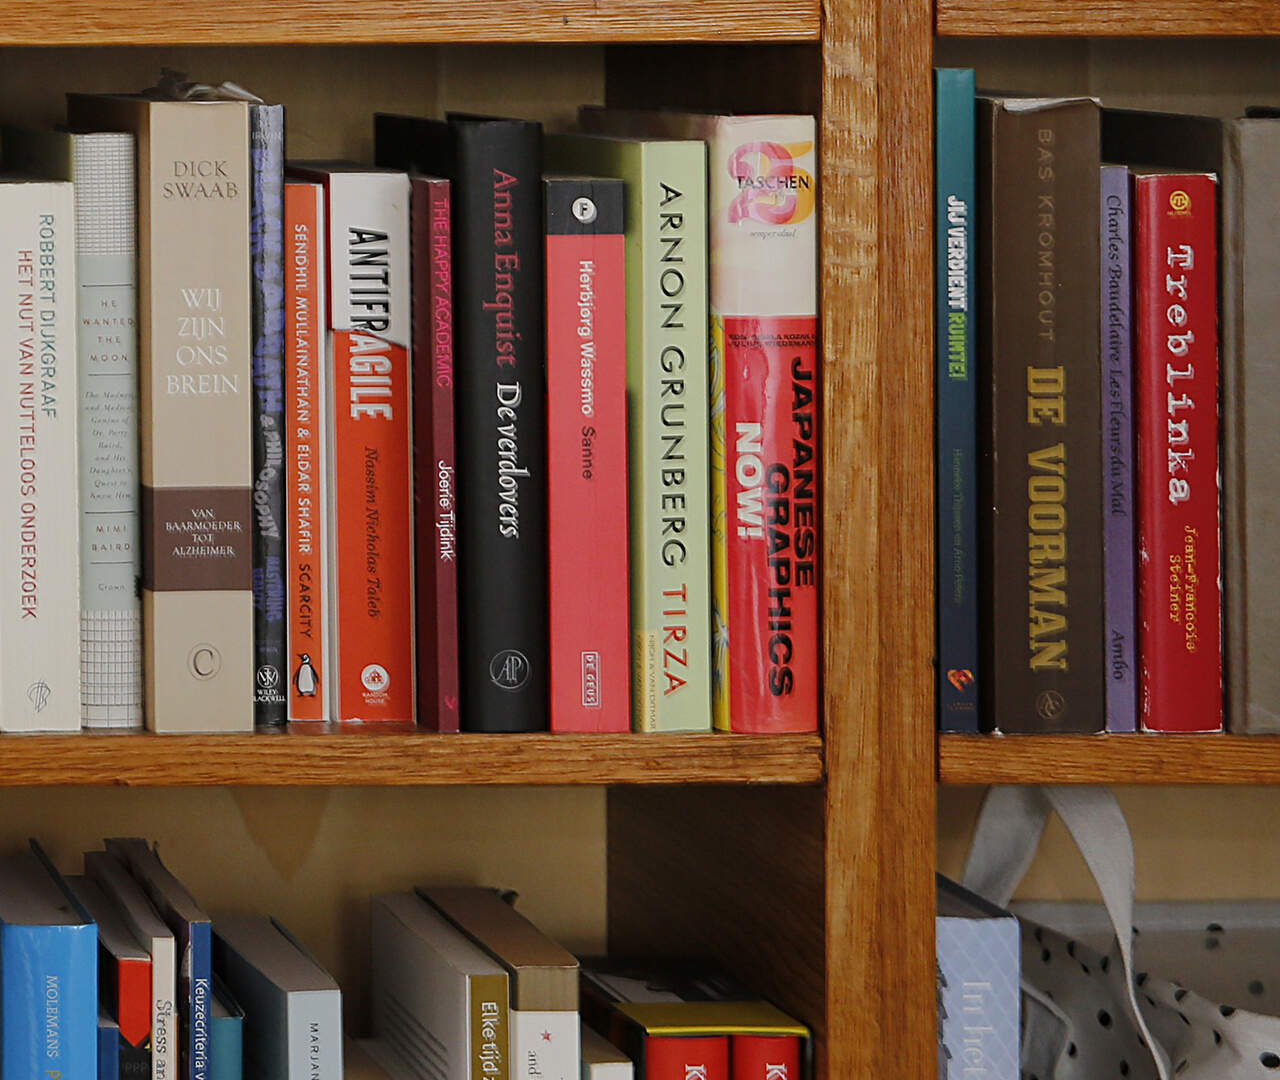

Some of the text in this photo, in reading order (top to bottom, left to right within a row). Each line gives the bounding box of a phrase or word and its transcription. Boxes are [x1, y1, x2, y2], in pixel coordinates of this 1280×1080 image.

[163, 183, 238, 199] SWAAB
[172, 161, 229, 176] DICK
[736, 175, 810, 189] TASCHEN
[39, 214, 57, 419] ROBBERT DIJKGRAAF
[181, 288, 223, 311] WIJ
[483, 168, 520, 368] Anna Enquist
[175, 346, 229, 365] ONS
[177, 317, 226, 337] ZIJN
[348, 227, 394, 421] ANTIFRAGILE
[1164, 245, 1195, 505] Treblinka
[18, 250, 37, 620] HET NUT VAN NUTTELOOS ONDERZOEK
[167, 375, 239, 395] BREIN
[295, 224, 312, 554] SENDHIL MULLAINATHAN & ELDAR SHAFIR
[495, 381, 527, 538] De verdovers
[659, 183, 688, 696] ARNON GRUNBERG TIRZA
[735, 422, 763, 540] NOW!
[792, 356, 814, 587] JAPANESE
[1027, 366, 1067, 671] DE VOORMAN
[298, 564, 313, 638] SCARCITY
[767, 463, 792, 696] GRAPHICS
[46, 975, 59, 1058] MOLEMANS
[194, 978, 208, 1068] Keuzecriteria
[480, 1001, 501, 1071] Elke tijd
[963, 980, 993, 1020] In
